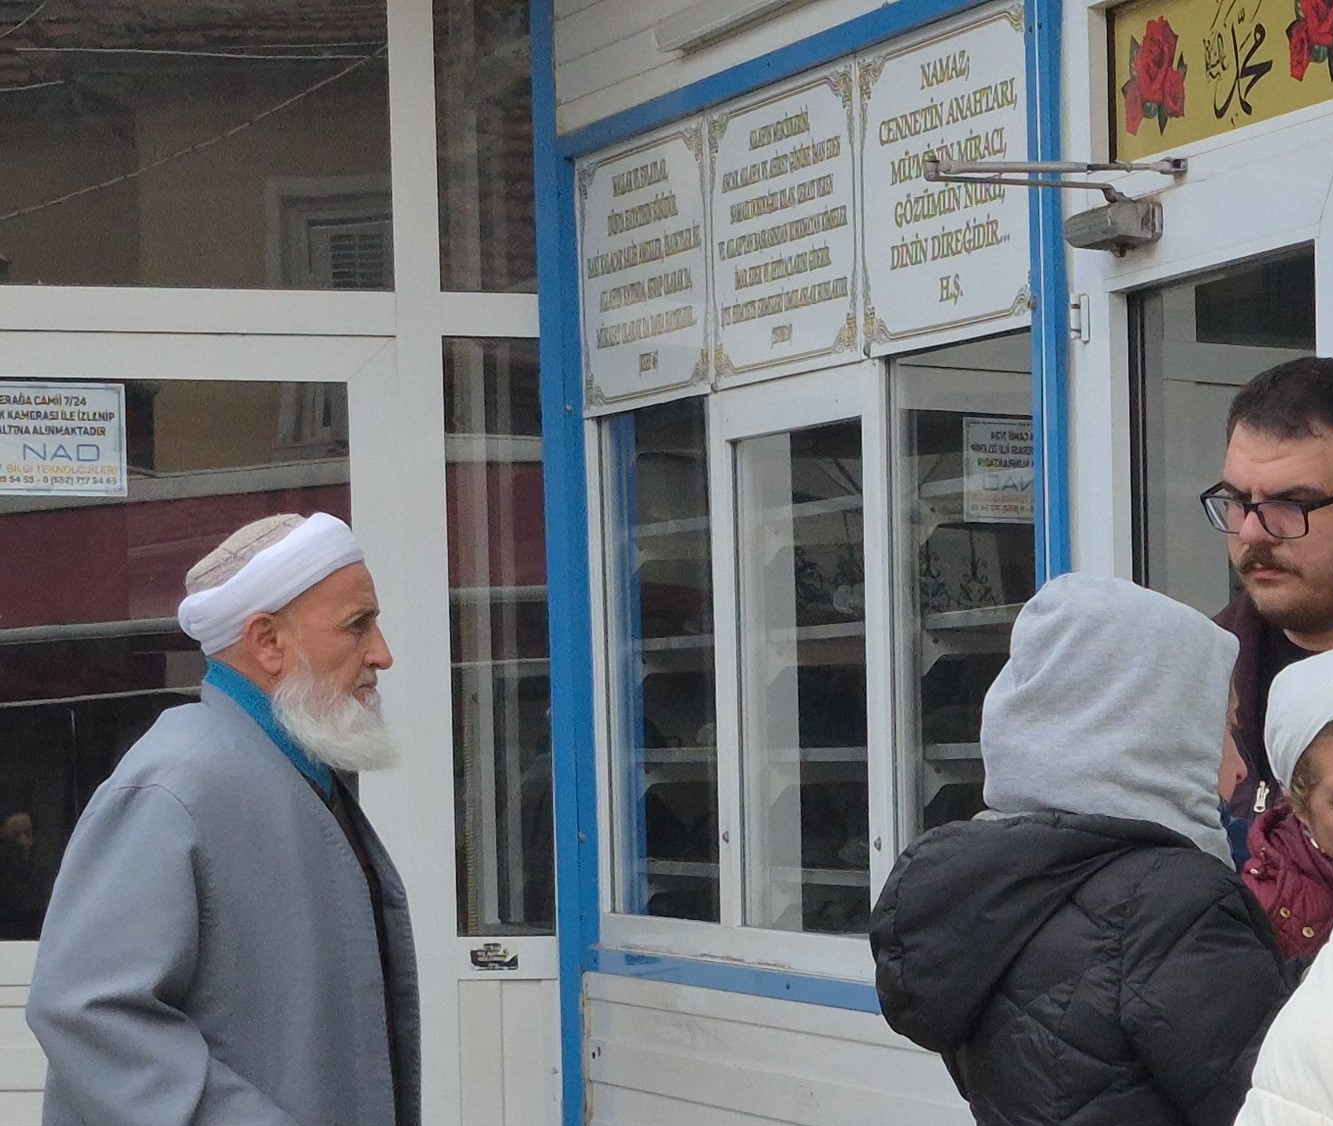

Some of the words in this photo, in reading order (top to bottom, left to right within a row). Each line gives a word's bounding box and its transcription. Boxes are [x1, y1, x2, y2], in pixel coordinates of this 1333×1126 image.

[919, 49, 971, 91] NAMAZ;
[878, 97, 945, 147] CENNETİN
[945, 77, 1018, 126] ANAHTARI,
[890, 232, 928, 271] DİNİN
[64, 396, 87, 407] 7/24
[22, 442, 101, 462] NAD
